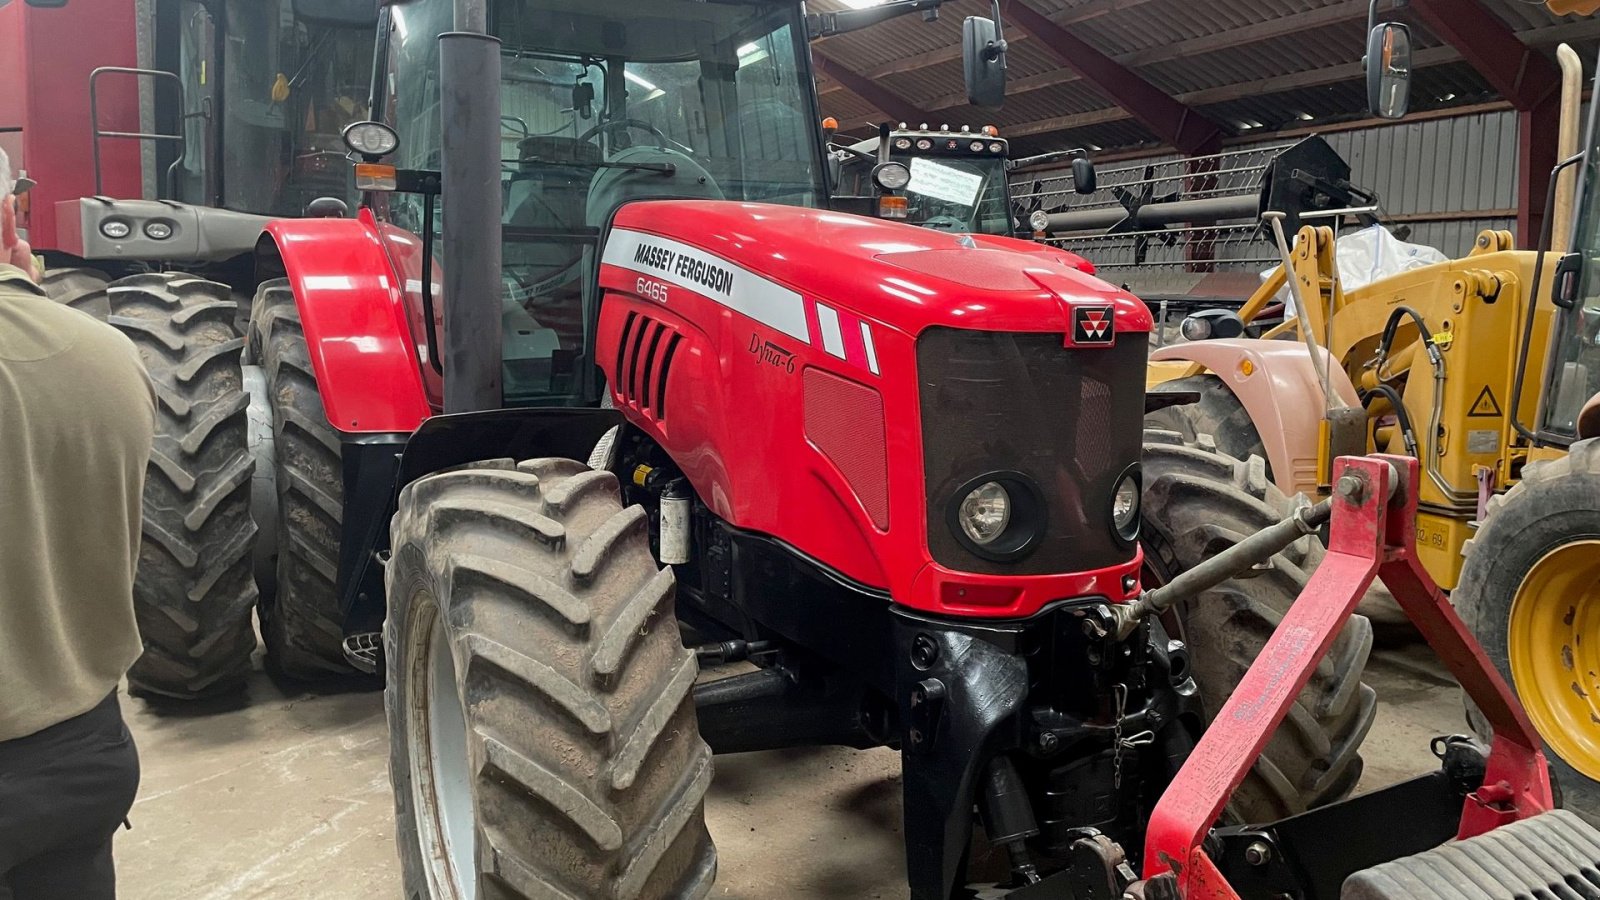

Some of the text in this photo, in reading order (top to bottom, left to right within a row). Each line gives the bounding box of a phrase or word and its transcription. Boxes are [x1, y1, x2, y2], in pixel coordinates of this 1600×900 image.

[634, 243, 734, 297] MASSEY FERGUSON
[636, 277, 668, 303] 6465
[749, 333, 798, 374] Dyna-6
